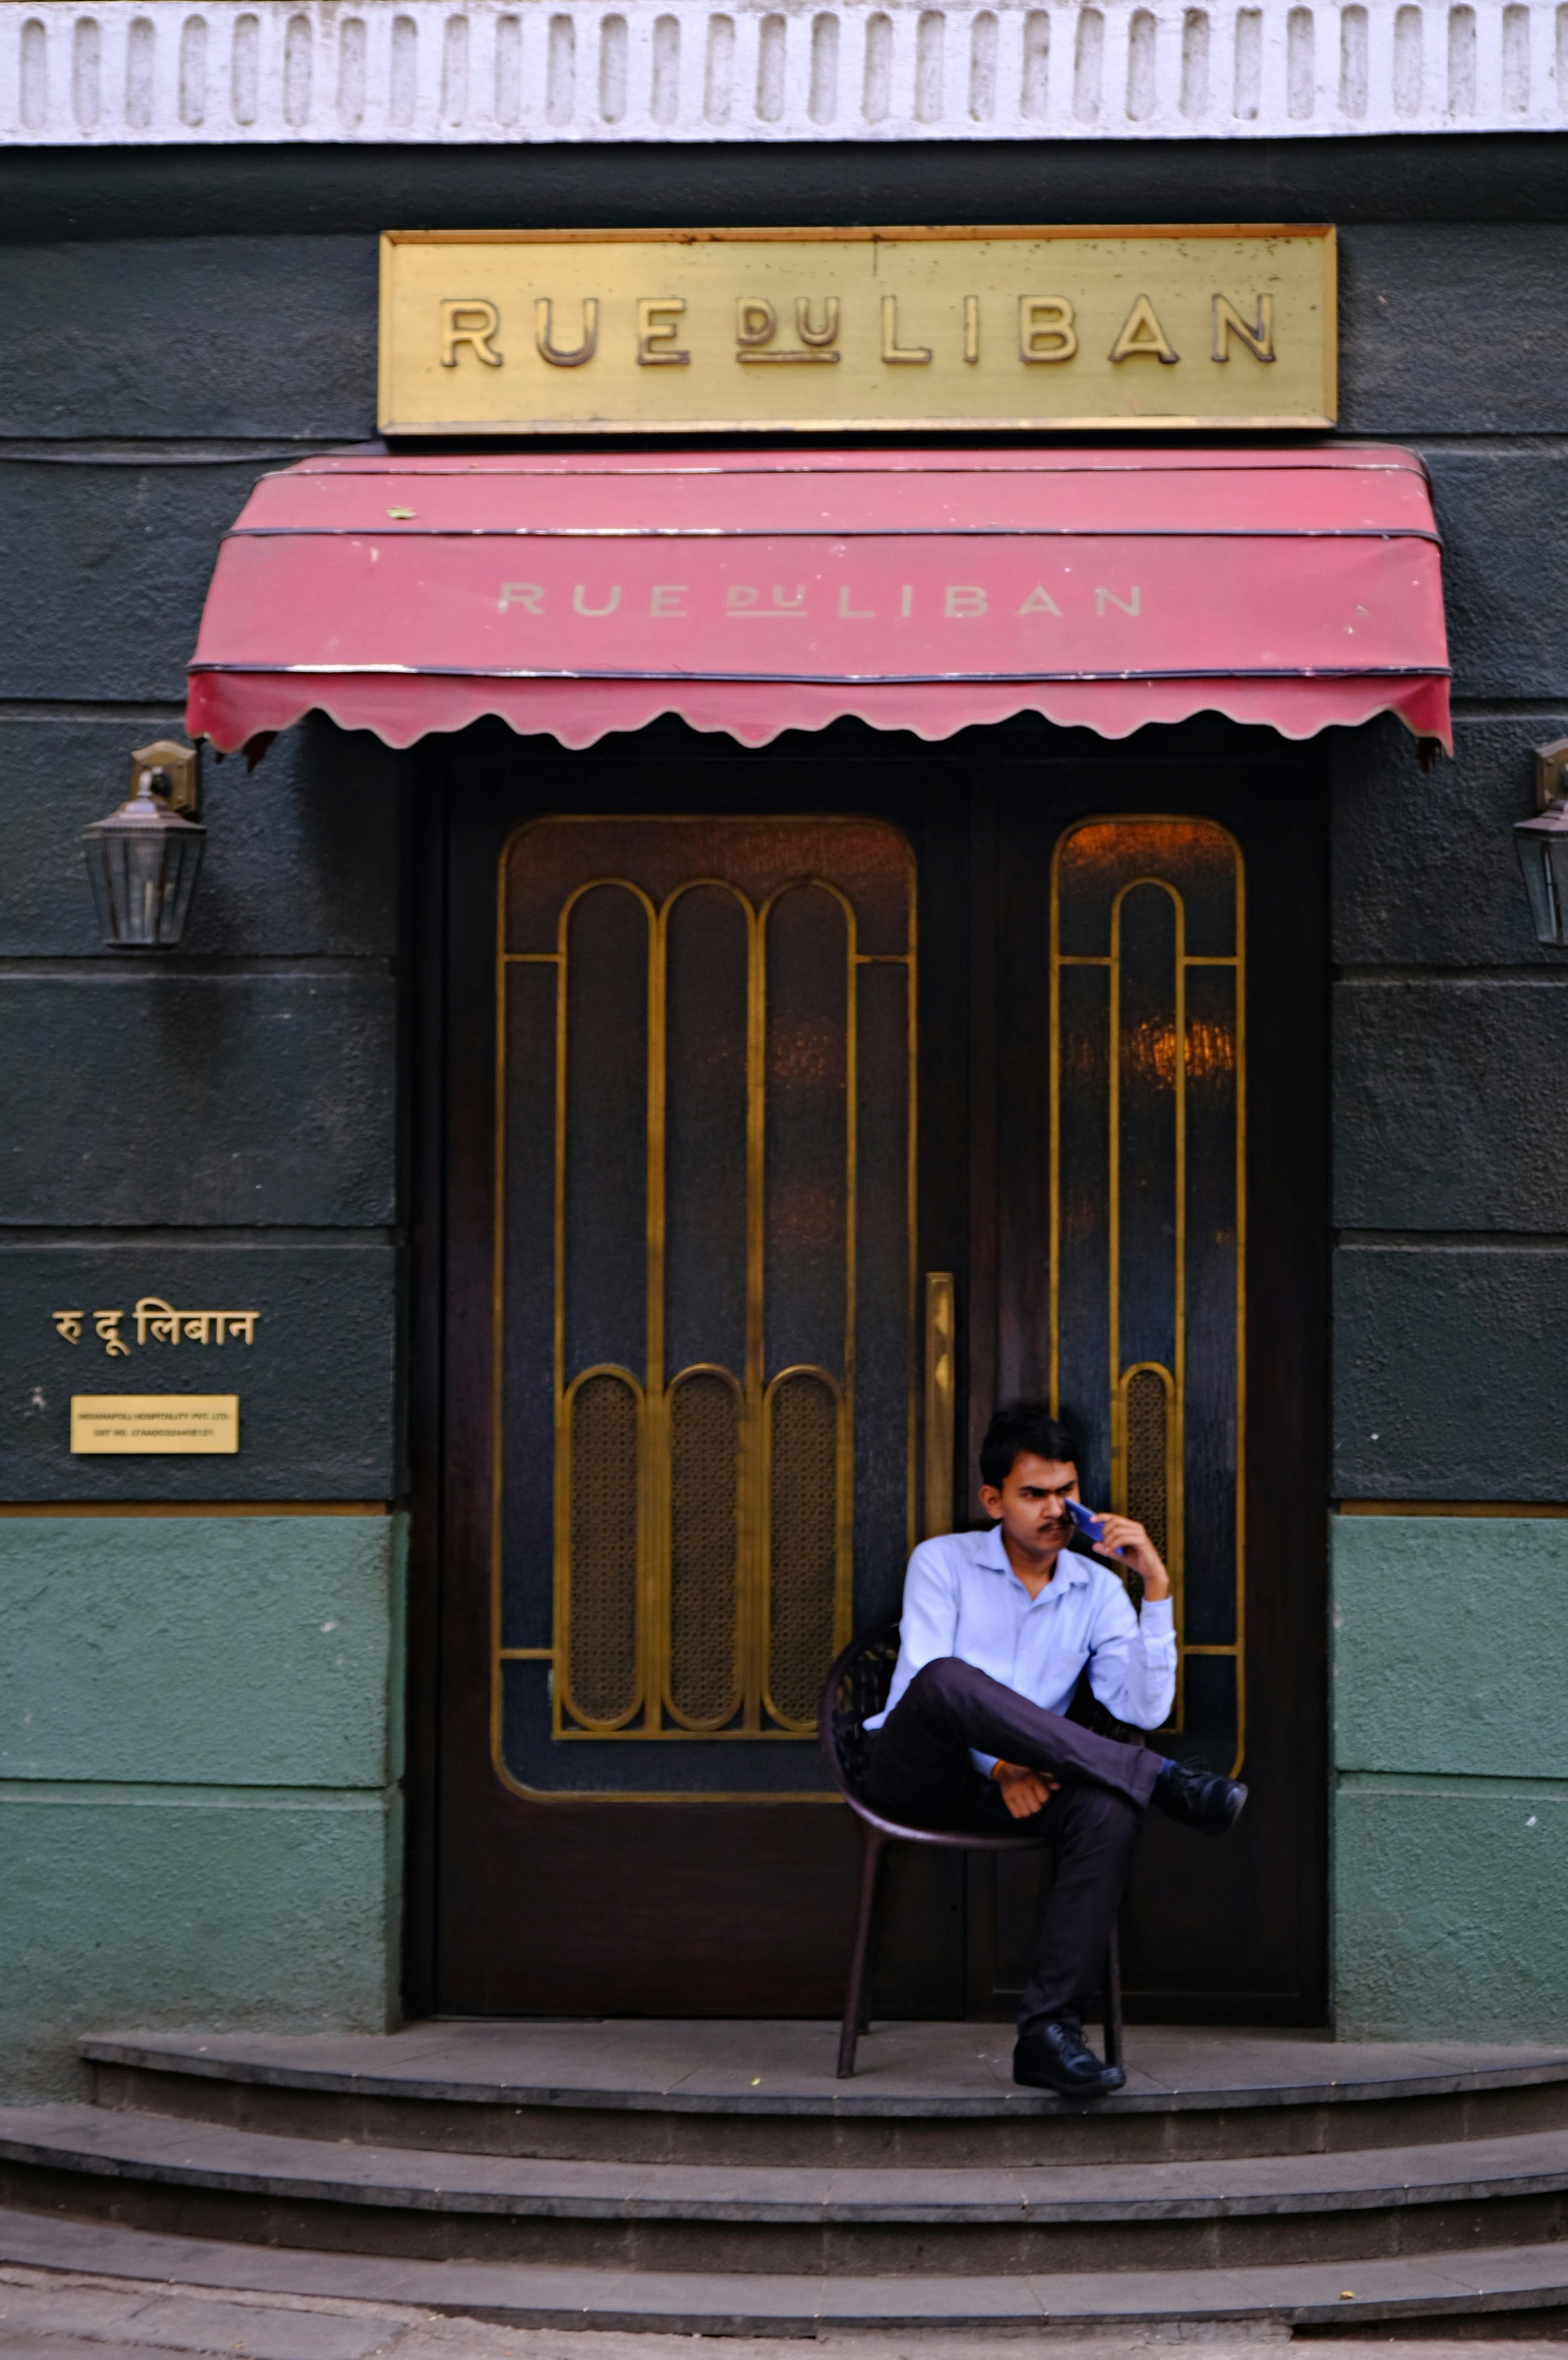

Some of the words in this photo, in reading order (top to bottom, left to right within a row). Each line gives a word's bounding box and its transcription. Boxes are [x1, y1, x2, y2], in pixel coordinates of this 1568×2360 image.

[440, 297, 690, 366] RUE
[735, 296, 841, 355] DU
[881, 293, 1276, 364] LIBAN
[498, 582, 689, 617] RUE
[727, 585, 807, 611] DU
[839, 585, 1141, 617] LIBAN
[93, 1310, 131, 1356] दू
[132, 1296, 261, 1346] लिबान
